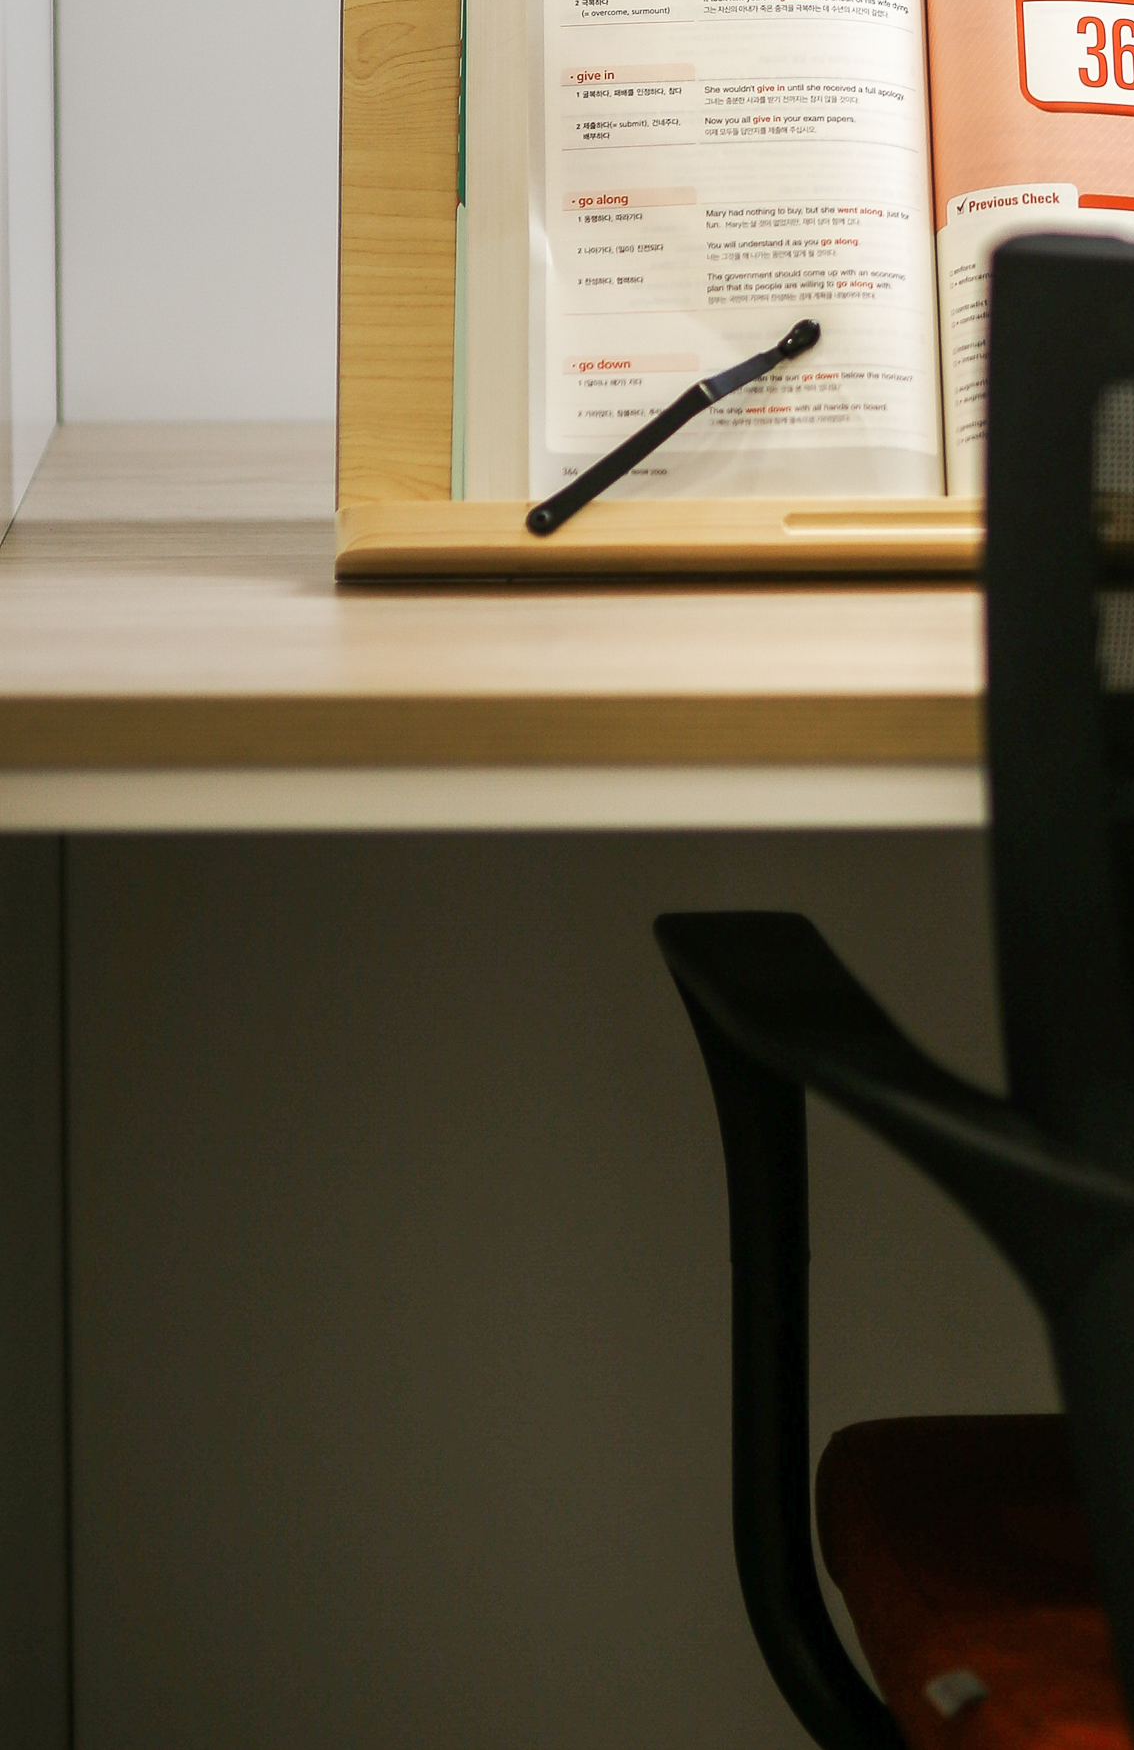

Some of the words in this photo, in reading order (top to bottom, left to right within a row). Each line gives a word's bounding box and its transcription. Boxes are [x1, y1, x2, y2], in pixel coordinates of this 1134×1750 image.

[591, 9, 630, 17] overcome,
[631, 7, 670, 15] surmount)
[576, 70, 601, 83] give
[604, 69, 615, 80] in
[704, 85, 720, 94] She
[723, 85, 755, 93] wouldn't
[756, 84, 775, 94] give
[823, 85, 856, 93] received
[865, 86, 876, 94] full
[704, 117, 723, 125] Now
[724, 116, 739, 125] you
[741, 115, 751, 123] all
[752, 115, 771, 125] give
[783, 115, 801, 124] your
[826, 115, 856, 123] papers.
[578, 197, 593, 208] go
[596, 194, 629, 206] along
[969, 196, 1019, 213] Previous
[1022, 192, 1060, 204] Check
[706, 241, 721, 250] You
[723, 240, 736, 248] will
[738, 239, 783, 248] understand
[803, 239, 818, 247] you
[820, 238, 832, 247] go
[579, 361, 594, 372] go
[597, 359, 631, 370] down
